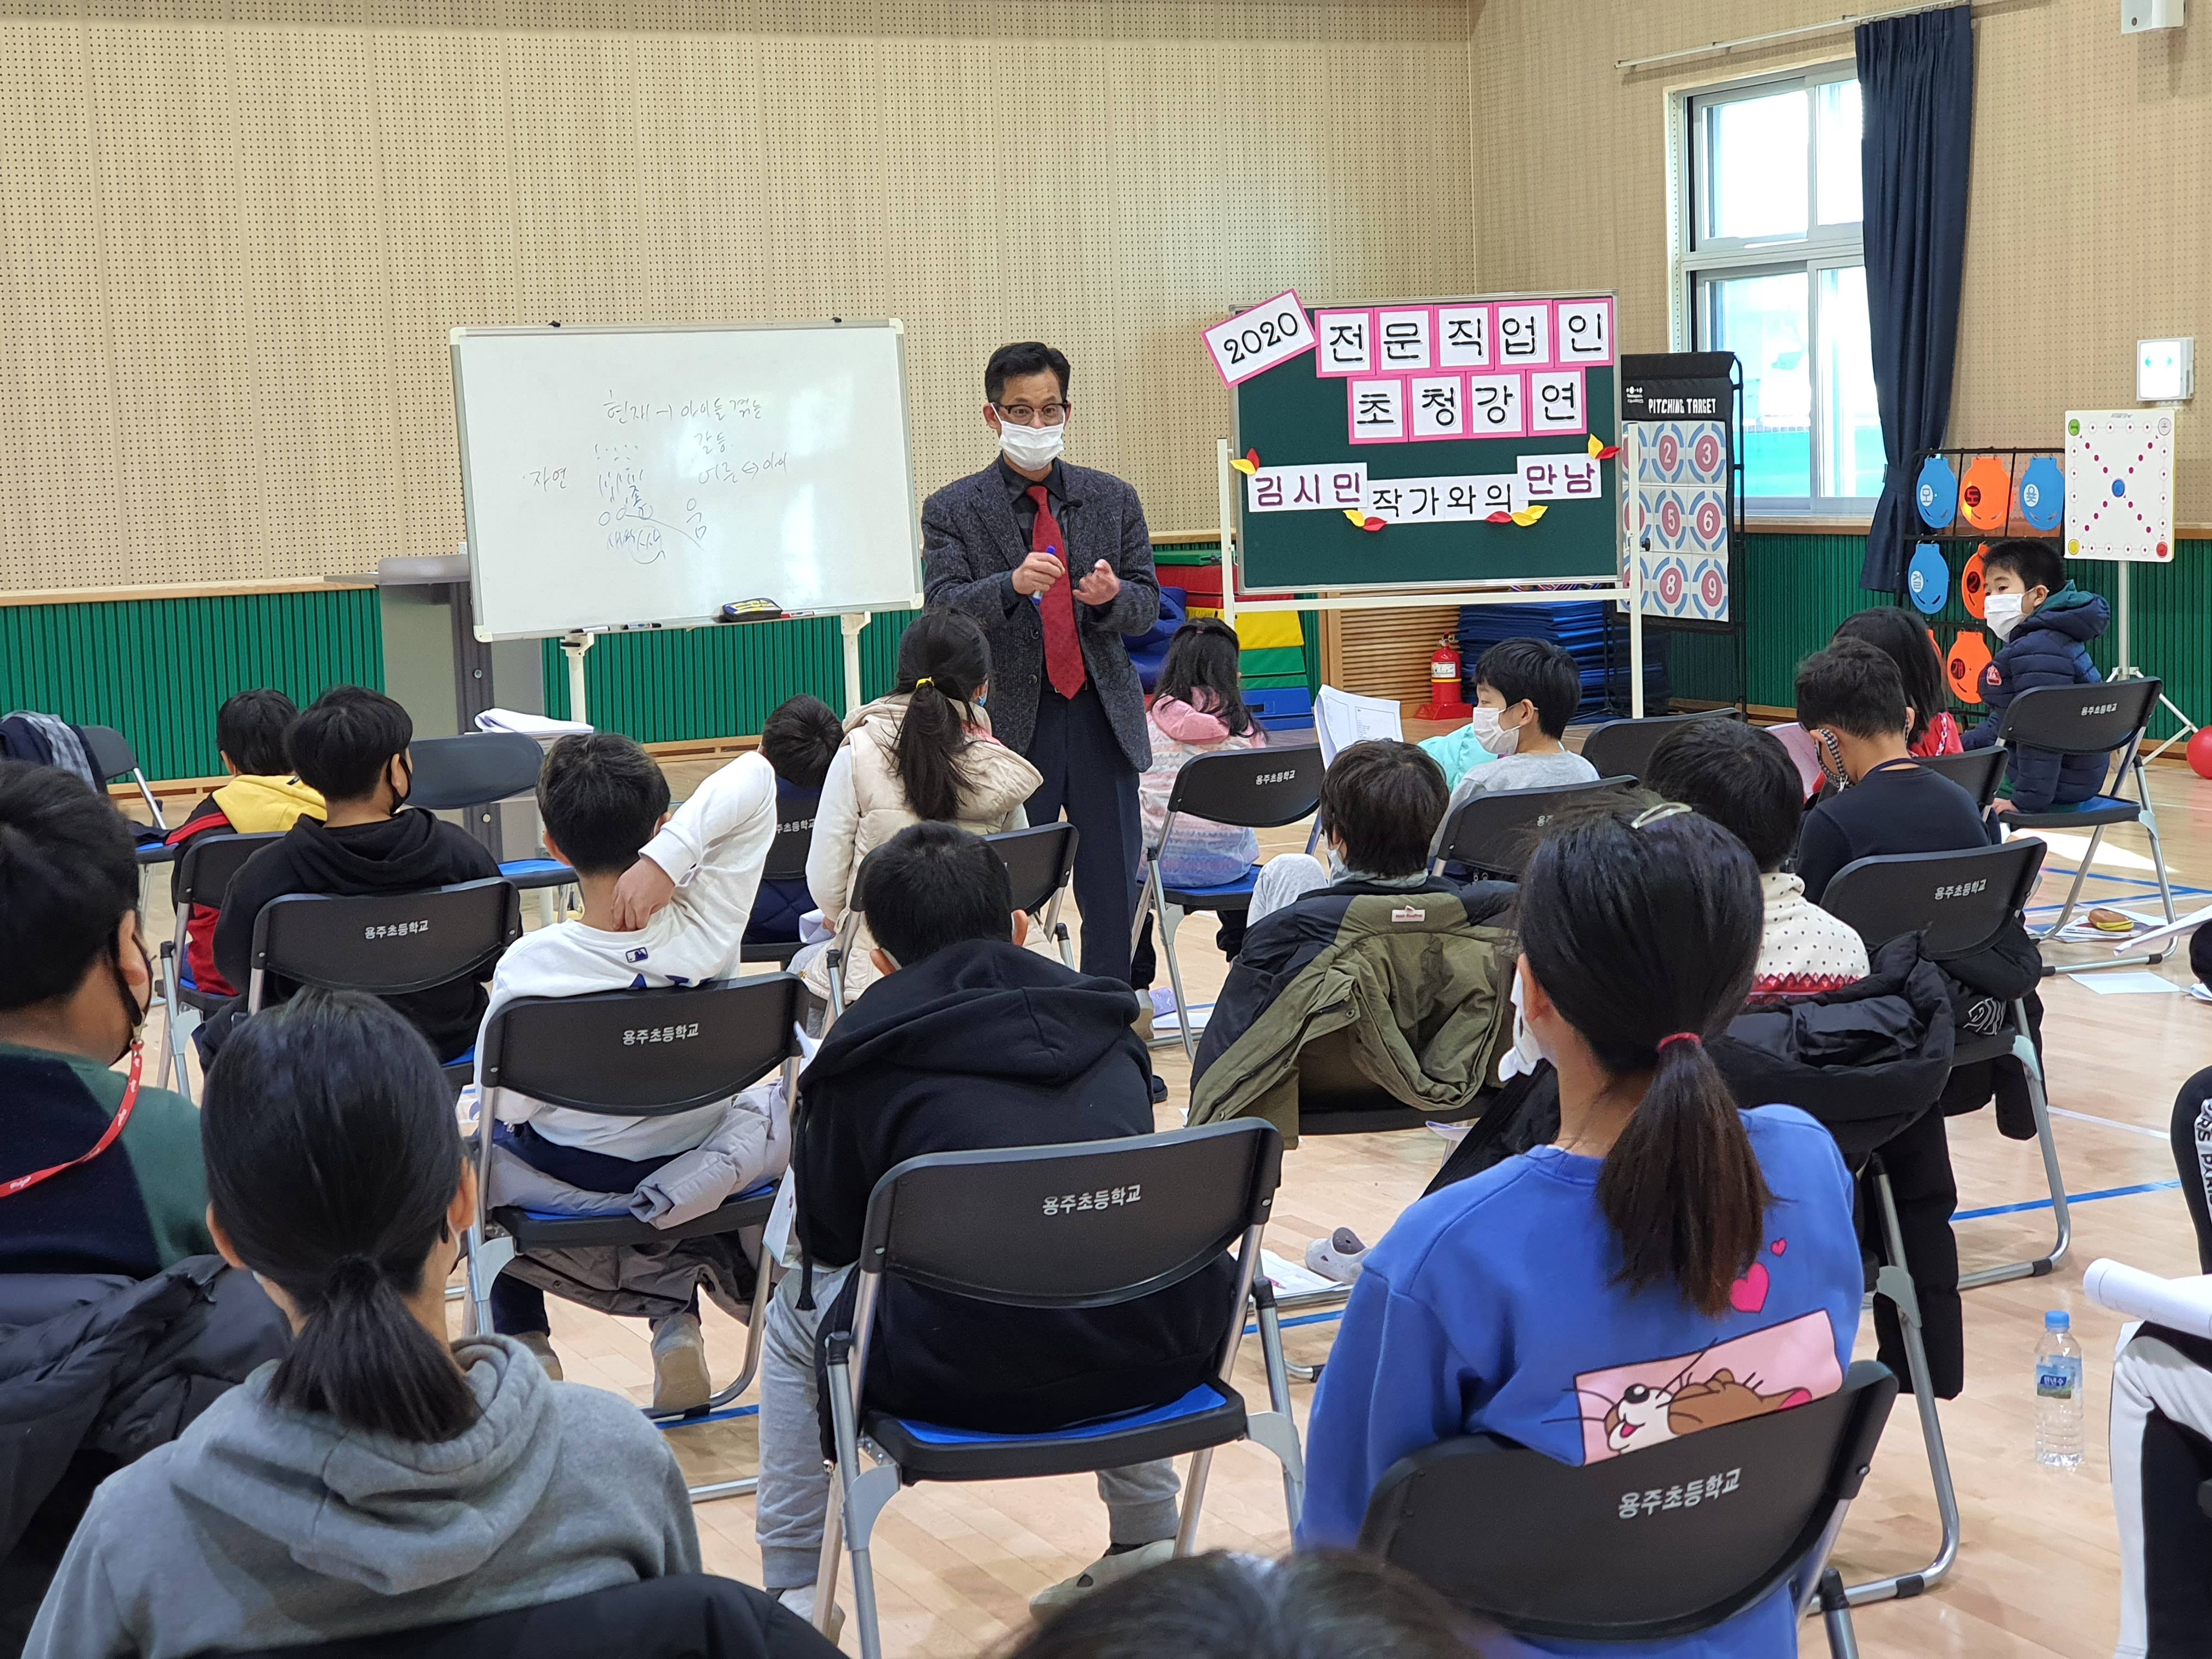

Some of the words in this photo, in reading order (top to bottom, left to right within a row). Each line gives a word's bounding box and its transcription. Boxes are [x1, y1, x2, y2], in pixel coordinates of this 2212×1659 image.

[1223, 312, 1300, 365] 2020
[603, 389, 650, 425] 현재
[681, 398, 725, 421] 아이들
[1356, 381, 1576, 426] 초청강연
[1648, 398, 1685, 414] PITCHING
[1686, 398, 1717, 414] TARGET
[694, 430, 726, 455] 갈등
[1664, 442, 1672, 464] 2
[1702, 443, 1712, 465] 3
[529, 466, 567, 492] 자연
[1255, 472, 1362, 507] 김시민
[1372, 483, 1511, 518] 작가와의
[1525, 462, 1596, 495] 만남
[1922, 488, 1931, 503] 모
[1967, 488, 1979, 504] 도
[1667, 509, 1675, 530] 5
[1703, 510, 1713, 532] 6
[1666, 574, 1676, 596] 8
[1708, 577, 1717, 599] 9
[1256, 769, 1295, 785] 용주초등학교
[776, 818, 815, 834] 주초등학교
[1934, 878, 1987, 900] 용주초등학교
[365, 919, 428, 939] 용주초등학교
[622, 1023, 699, 1045] 용주초등학교
[1042, 1184, 1142, 1216] 용주초등학교
[1618, 1467, 1742, 1519] 용주초등학교
